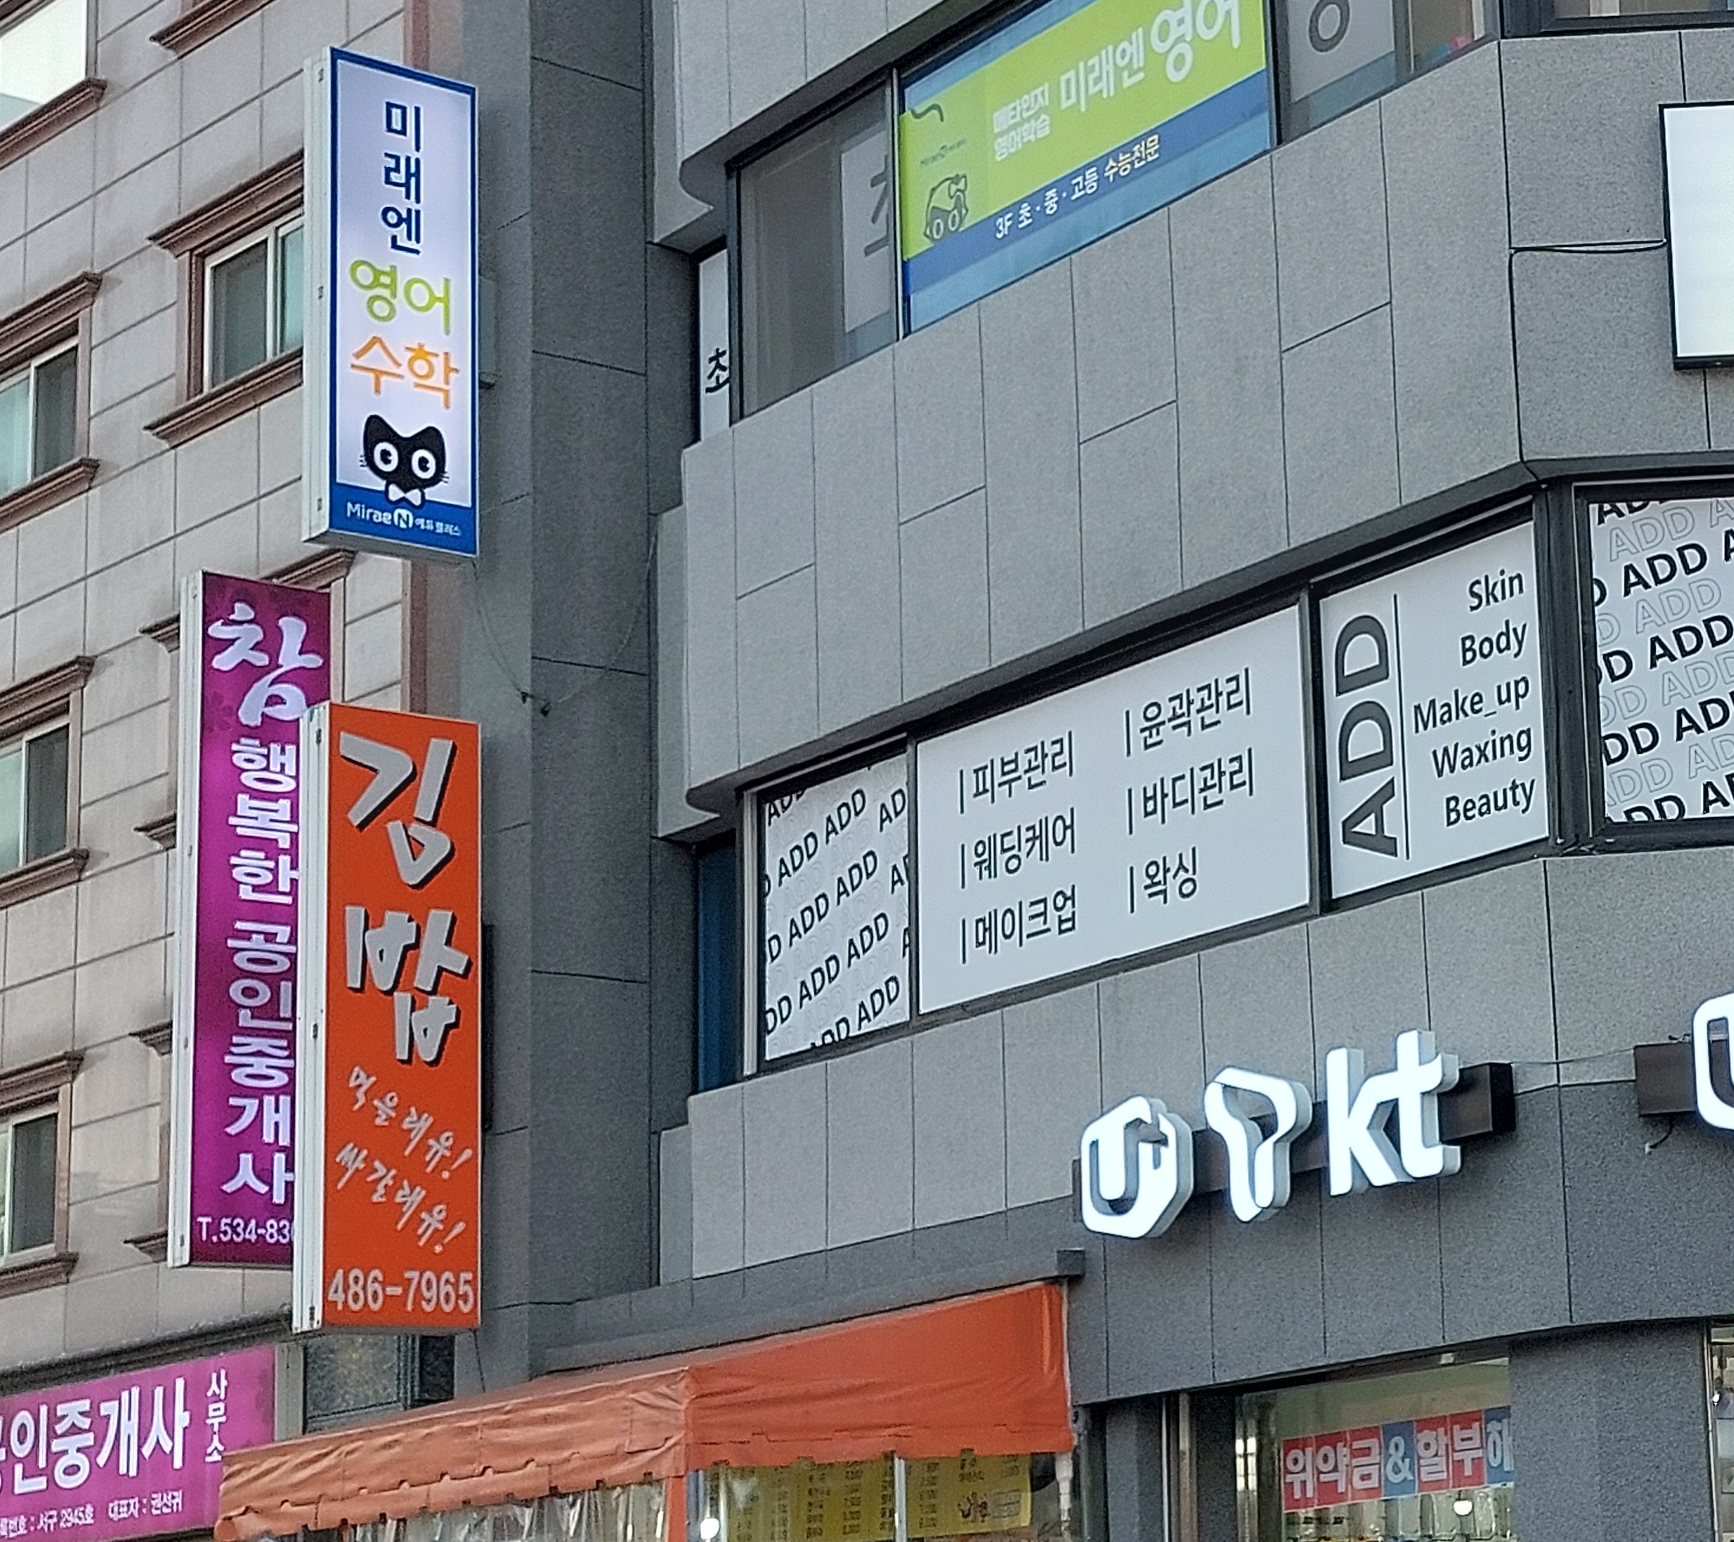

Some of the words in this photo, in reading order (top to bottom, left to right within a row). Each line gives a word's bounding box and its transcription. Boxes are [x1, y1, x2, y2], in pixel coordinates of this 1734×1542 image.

[1059, 26, 1146, 112] 미래엔
[381, 100, 423, 256] 미래엔
[994, 213, 1013, 239] 3F
[1103, 134, 1160, 182] 수능전문
[349, 258, 451, 336] 영어
[350, 335, 460, 409] 수학
[1467, 568, 1525, 613] Skin
[1622, 542, 1708, 598] ADD
[207, 600, 325, 727] 참
[1460, 619, 1528, 667] Body
[971, 730, 1076, 806] 피부관리
[1140, 666, 1252, 752] 윤곽관리
[1334, 614, 1398, 858] ADD
[1412, 674, 1531, 735] Make_up
[1431, 726, 1533, 779] Waxing
[228, 737, 298, 906] 행복한
[826, 788, 866, 845] ADD
[971, 807, 1078, 884] 웨딩케어
[1142, 746, 1255, 825] 바디관리
[1443, 777, 1536, 828] Beauty
[338, 729, 472, 1065] 김밥
[778, 831, 818, 888] ADD
[973, 886, 1080, 957] 메이크업
[1142, 845, 1199, 905] 왁싱
[221, 917, 297, 1206] 공인중개사
[1325, 1027, 1462, 1198] kt
[328, 1267, 475, 1314] 486-7965
[204, 1368, 228, 1463] 사무소
